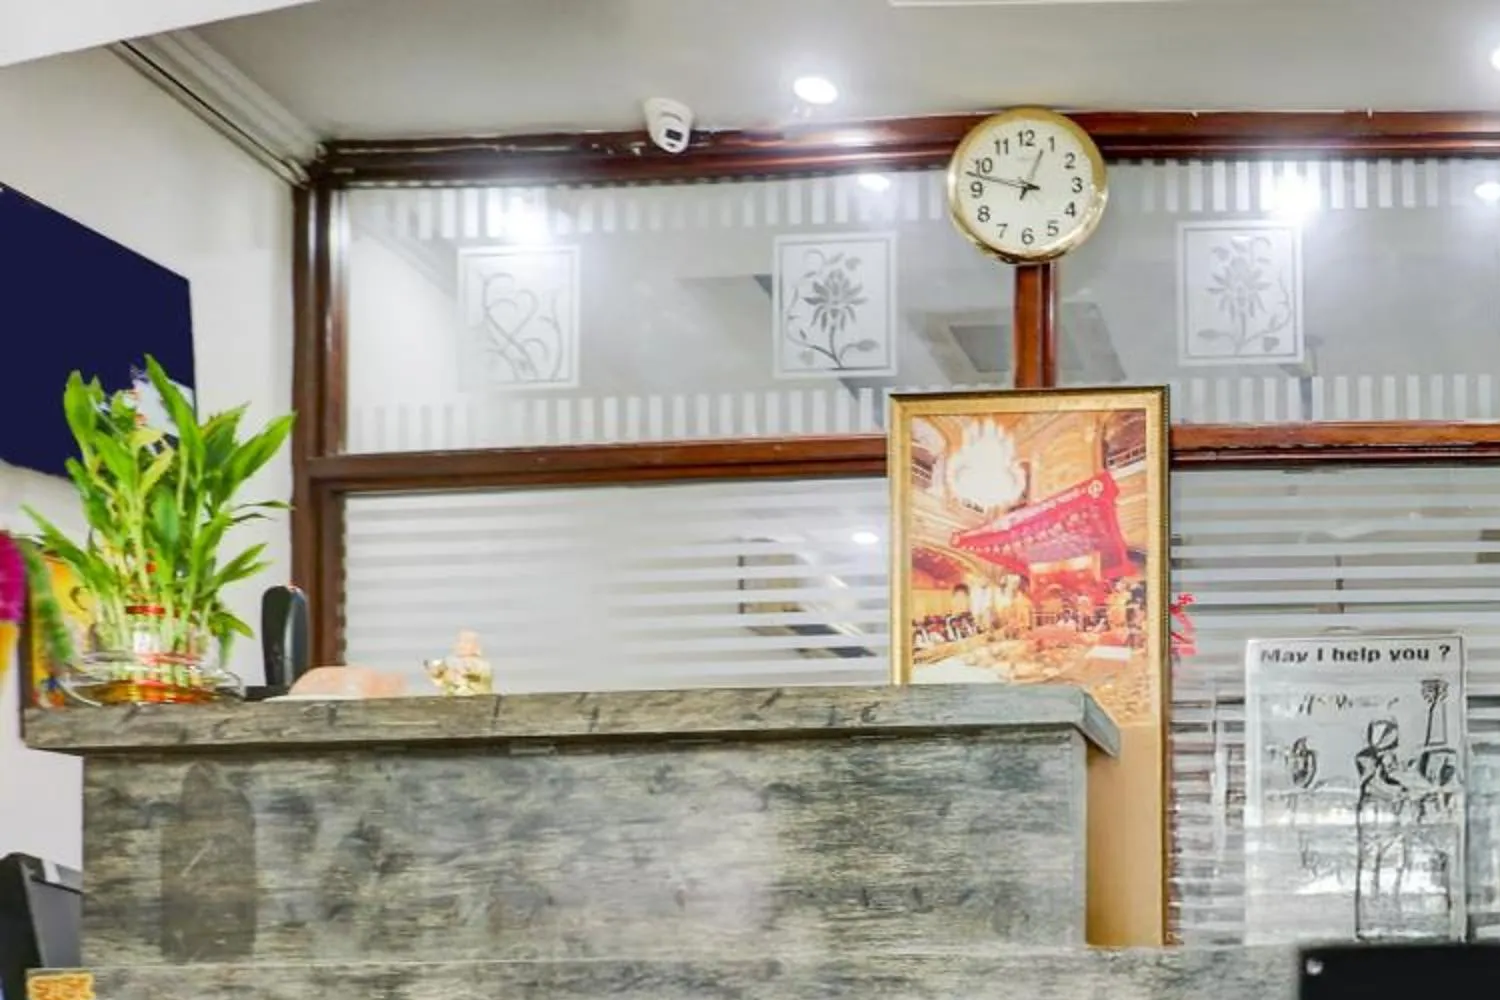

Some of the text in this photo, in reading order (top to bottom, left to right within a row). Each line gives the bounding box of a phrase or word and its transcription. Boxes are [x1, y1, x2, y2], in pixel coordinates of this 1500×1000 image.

[994, 138, 1009, 155] 11
[1017, 129, 1035, 147] 12
[1047, 136, 1056, 151] 1
[975, 157, 993, 176] 10
[1064, 152, 1076, 169] 2
[970, 181, 983, 198] 9
[1071, 177, 1083, 193] 3
[977, 205, 991, 222] 8
[1063, 202, 1076, 218] 4
[996, 223, 1009, 239] 7
[1021, 228, 1034, 245] 6
[1047, 220, 1059, 236] 5
[1261, 644, 1451, 664] May I help you ?
